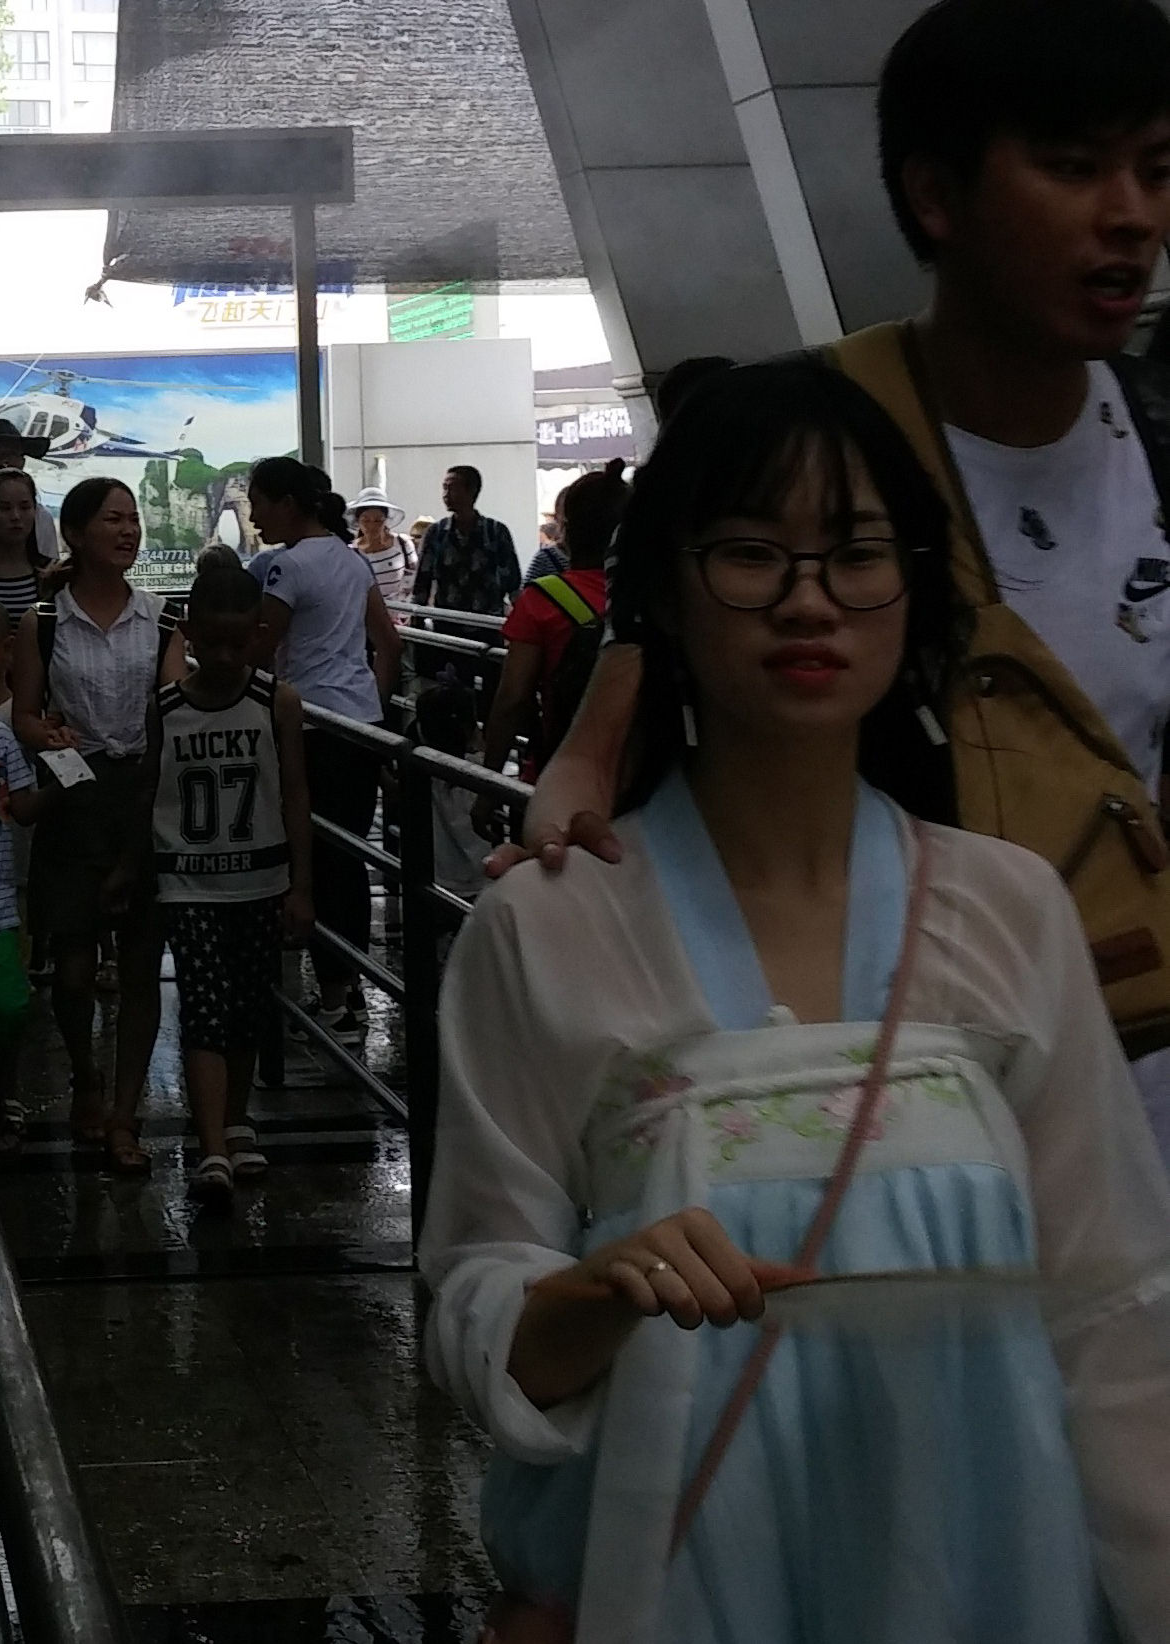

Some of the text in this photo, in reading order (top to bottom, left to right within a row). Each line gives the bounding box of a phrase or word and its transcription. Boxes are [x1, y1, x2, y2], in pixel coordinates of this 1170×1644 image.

[173, 729, 261, 762] LUCKY
[178, 763, 260, 844] 07
[175, 854, 252, 872] NUMBER
